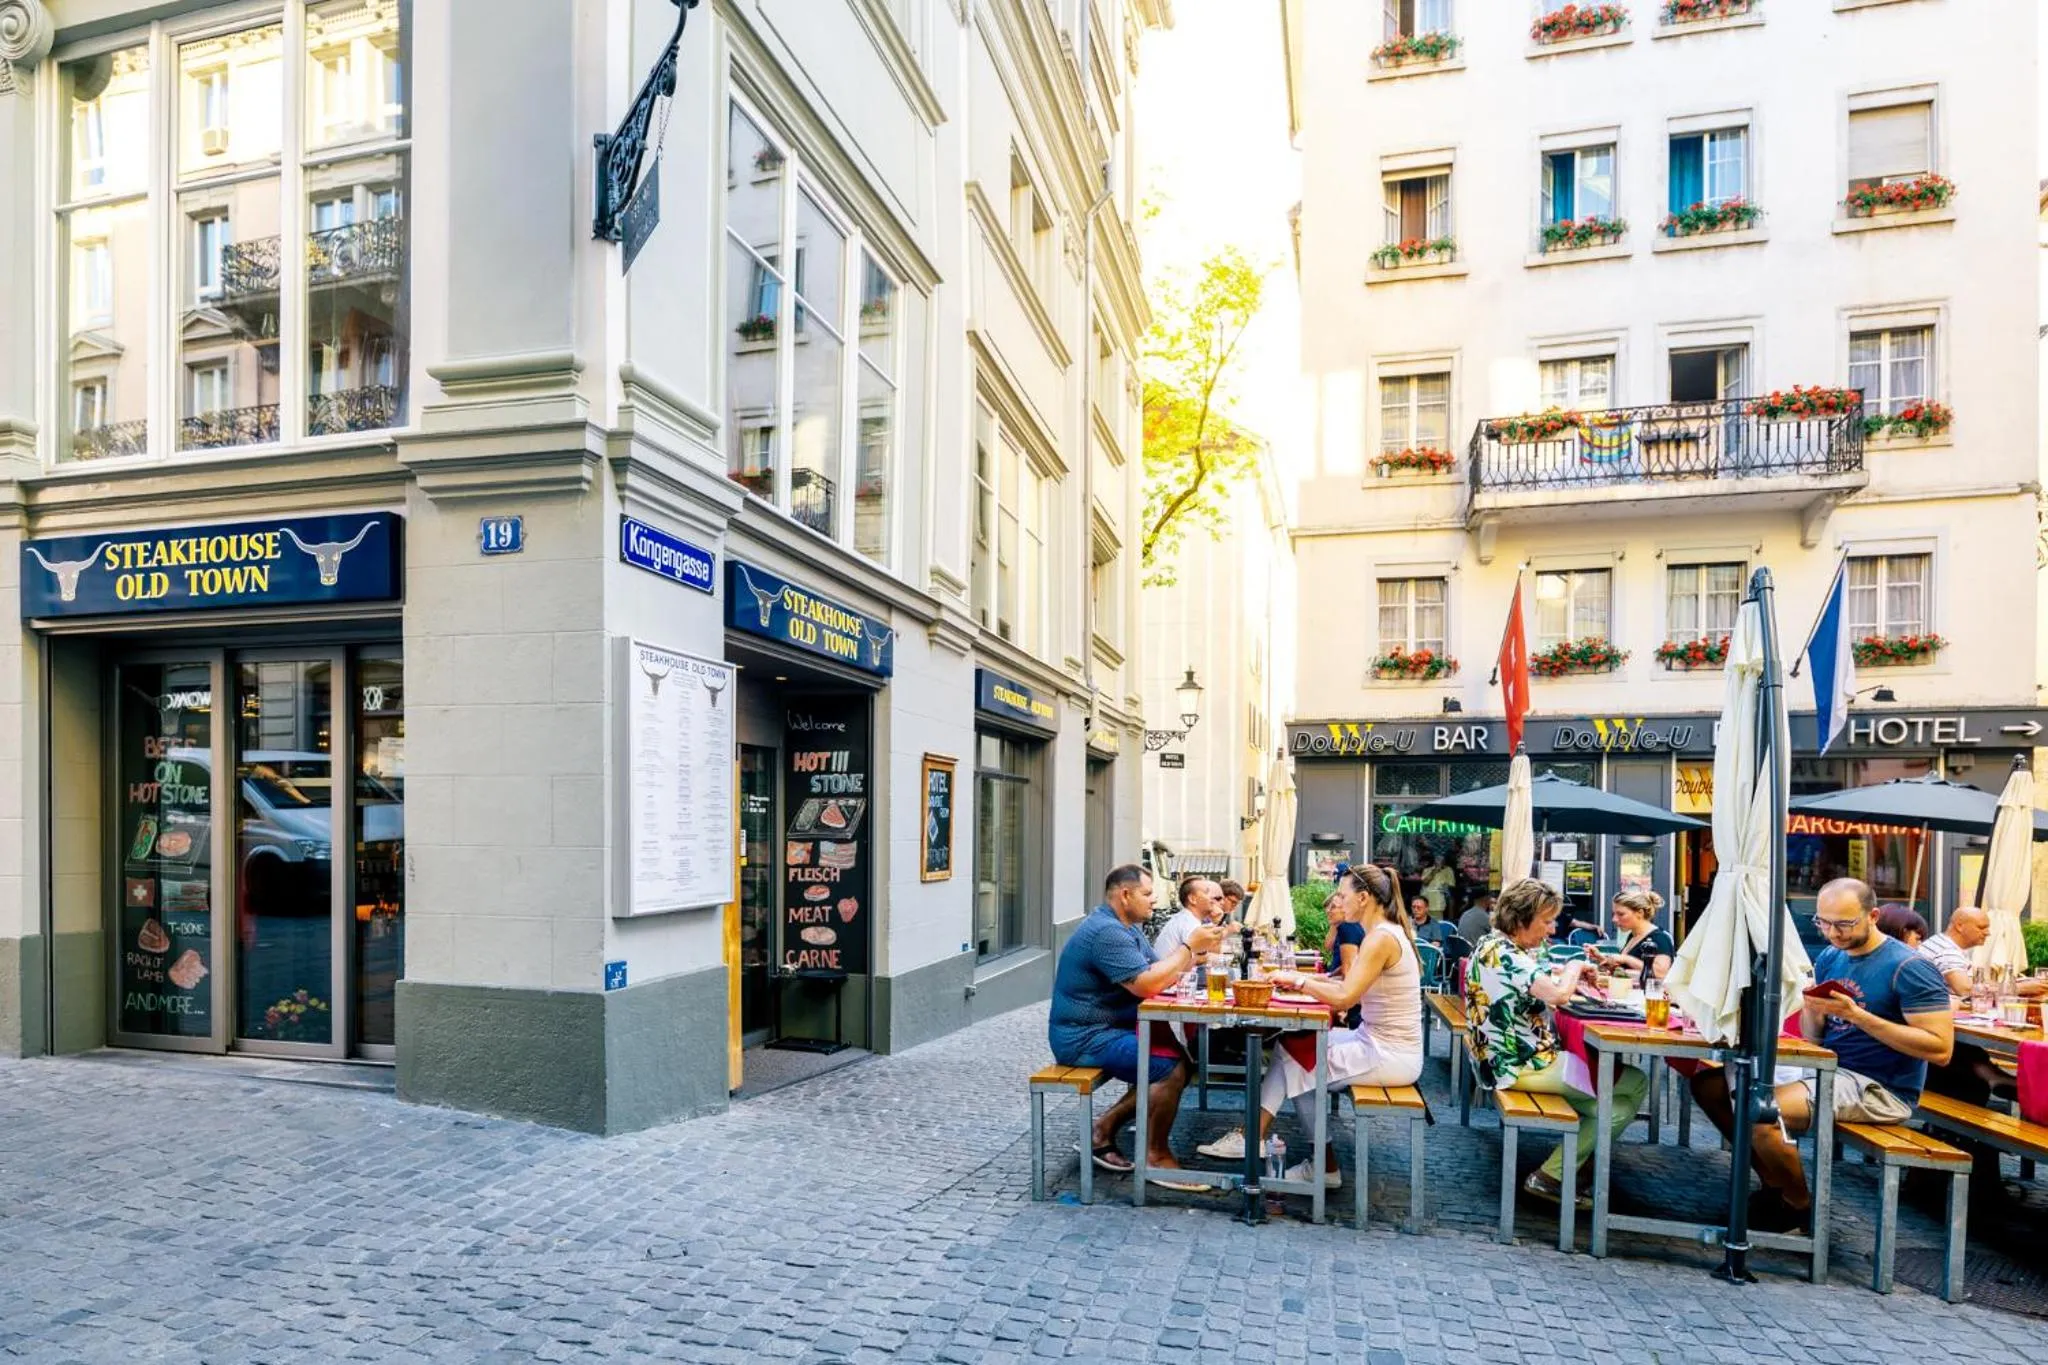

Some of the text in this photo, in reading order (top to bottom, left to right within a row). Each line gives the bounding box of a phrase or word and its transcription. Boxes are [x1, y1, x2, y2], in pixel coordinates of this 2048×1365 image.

[487, 521, 512, 548] 19
[104, 531, 282, 570] STEAKHOUSE
[115, 565, 271, 600] OLD TOWN
[782, 588, 863, 639] STEAKHOUSE
[788, 617, 858, 661] OLD TOWN
[639, 650, 726, 680] STEAKHOUSE OLD TOWN
[787, 708, 847, 732] Welcome
[1849, 716, 1982, 745] HOTEL
[1292, 725, 1489, 753] Double-U BAR
[1553, 724, 1694, 750] Double-U
[154, 761, 182, 784] ON
[810, 773, 865, 794] STONE
[129, 782, 209, 805] HOT STONE
[788, 867, 841, 882] FLEISCH
[788, 905, 833, 923] MEAT
[170, 921, 205, 935] T-BONE
[785, 949, 843, 969] CARNE
